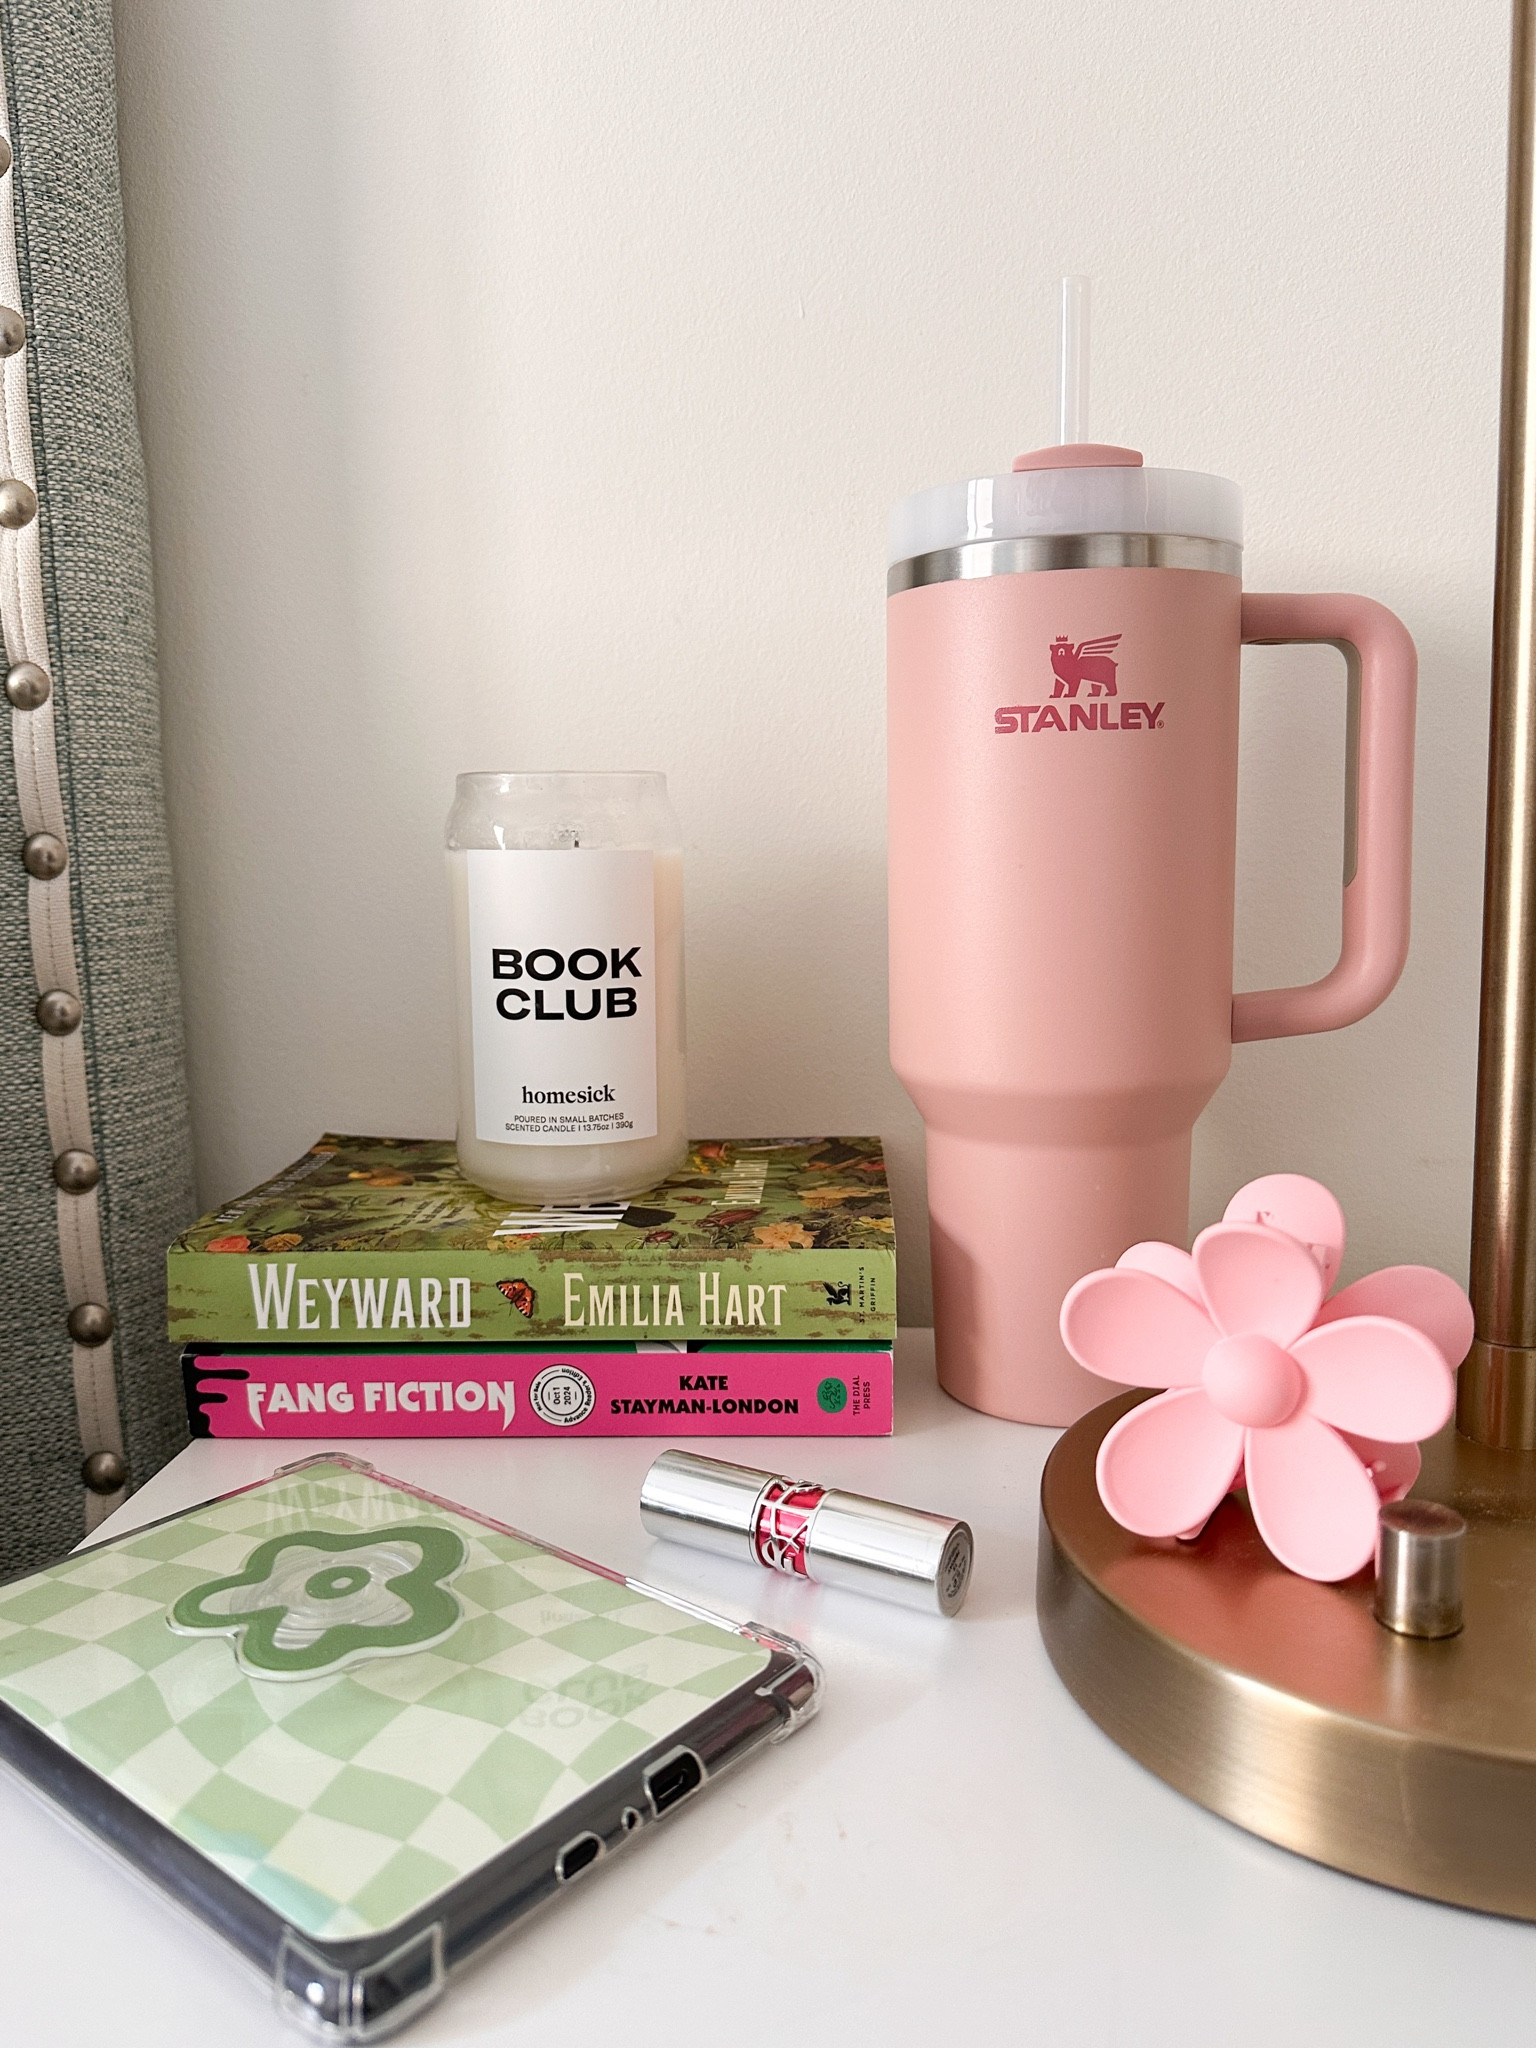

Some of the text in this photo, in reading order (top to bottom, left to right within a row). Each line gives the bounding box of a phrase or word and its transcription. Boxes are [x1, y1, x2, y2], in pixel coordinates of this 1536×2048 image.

[994, 702, 1165, 734] STANLEY
[492, 947, 642, 981] BOOK
[496, 987, 637, 1020] CLUB
[522, 1084, 616, 1104] homesick
[505, 1122, 541, 1132] SCENTED
[542, 1124, 576, 1132] CANDLE
[582, 1122, 610, 1132] 13.75oz
[615, 1120, 634, 1130] 390g
[514, 1112, 624, 1124] POURED IN SMALL BATCHES
[679, 1376, 728, 1390] KATE
[852, 1375, 860, 1397] DIAL
[553, 1391, 561, 1405] Oct
[563, 1386, 572, 1405] 2024
[564, 1407, 588, 1424] Advance
[582, 1380, 592, 1406] Reader's
[863, 1381, 871, 1409] PRESS
[246, 1380, 516, 1432] FANG FICTION
[610, 1398, 799, 1414] STAYMAN-LONDON
